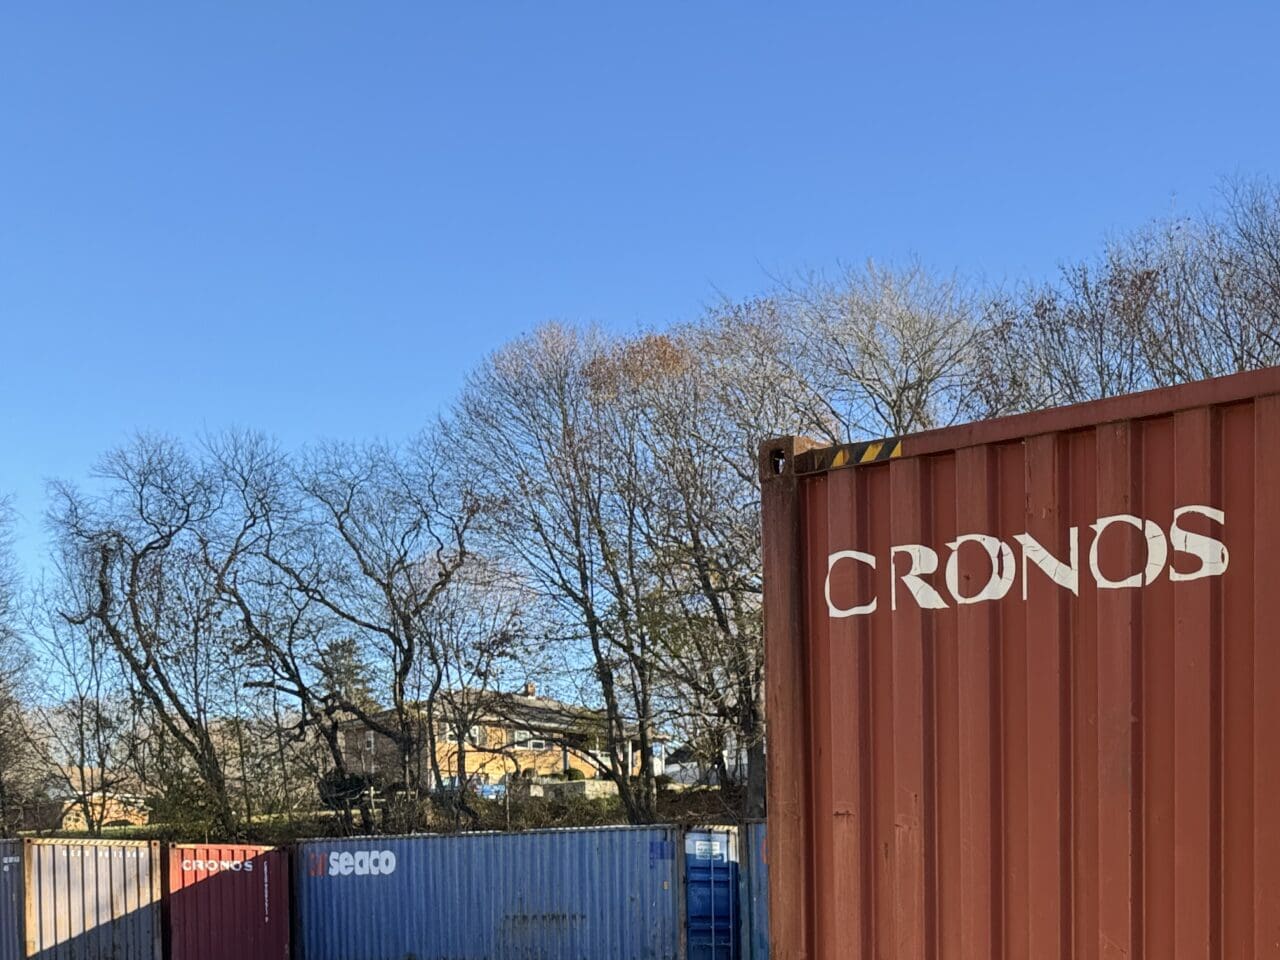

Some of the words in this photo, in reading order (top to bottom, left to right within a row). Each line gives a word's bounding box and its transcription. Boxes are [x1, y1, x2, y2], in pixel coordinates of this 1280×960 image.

[824, 505, 1230, 618] CRONOS
[181, 859, 254, 872] CRONOS
[328, 849, 397, 877] seaco
